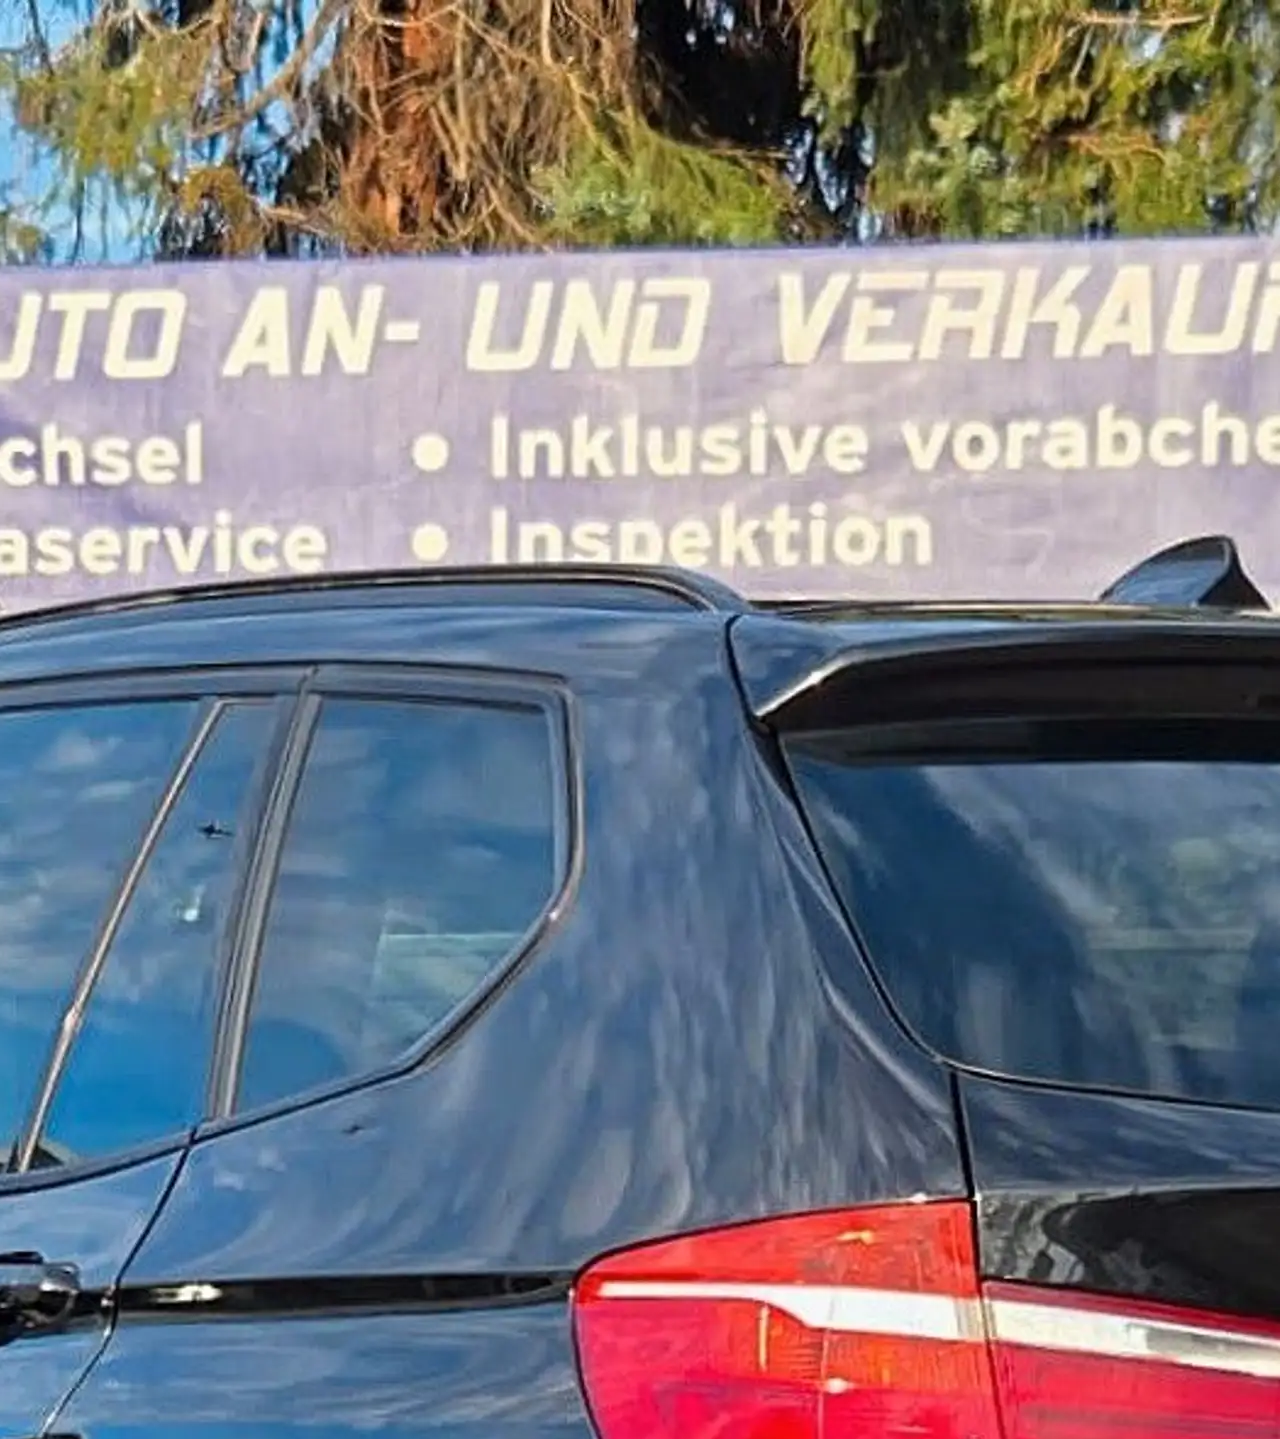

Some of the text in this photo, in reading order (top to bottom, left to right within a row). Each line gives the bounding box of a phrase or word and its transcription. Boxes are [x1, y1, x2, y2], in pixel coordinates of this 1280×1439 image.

[223, 284, 419, 377] AN-
[466, 278, 709, 371] UND
[491, 411, 868, 477] Inklusive
[491, 502, 932, 567] Inspektion
